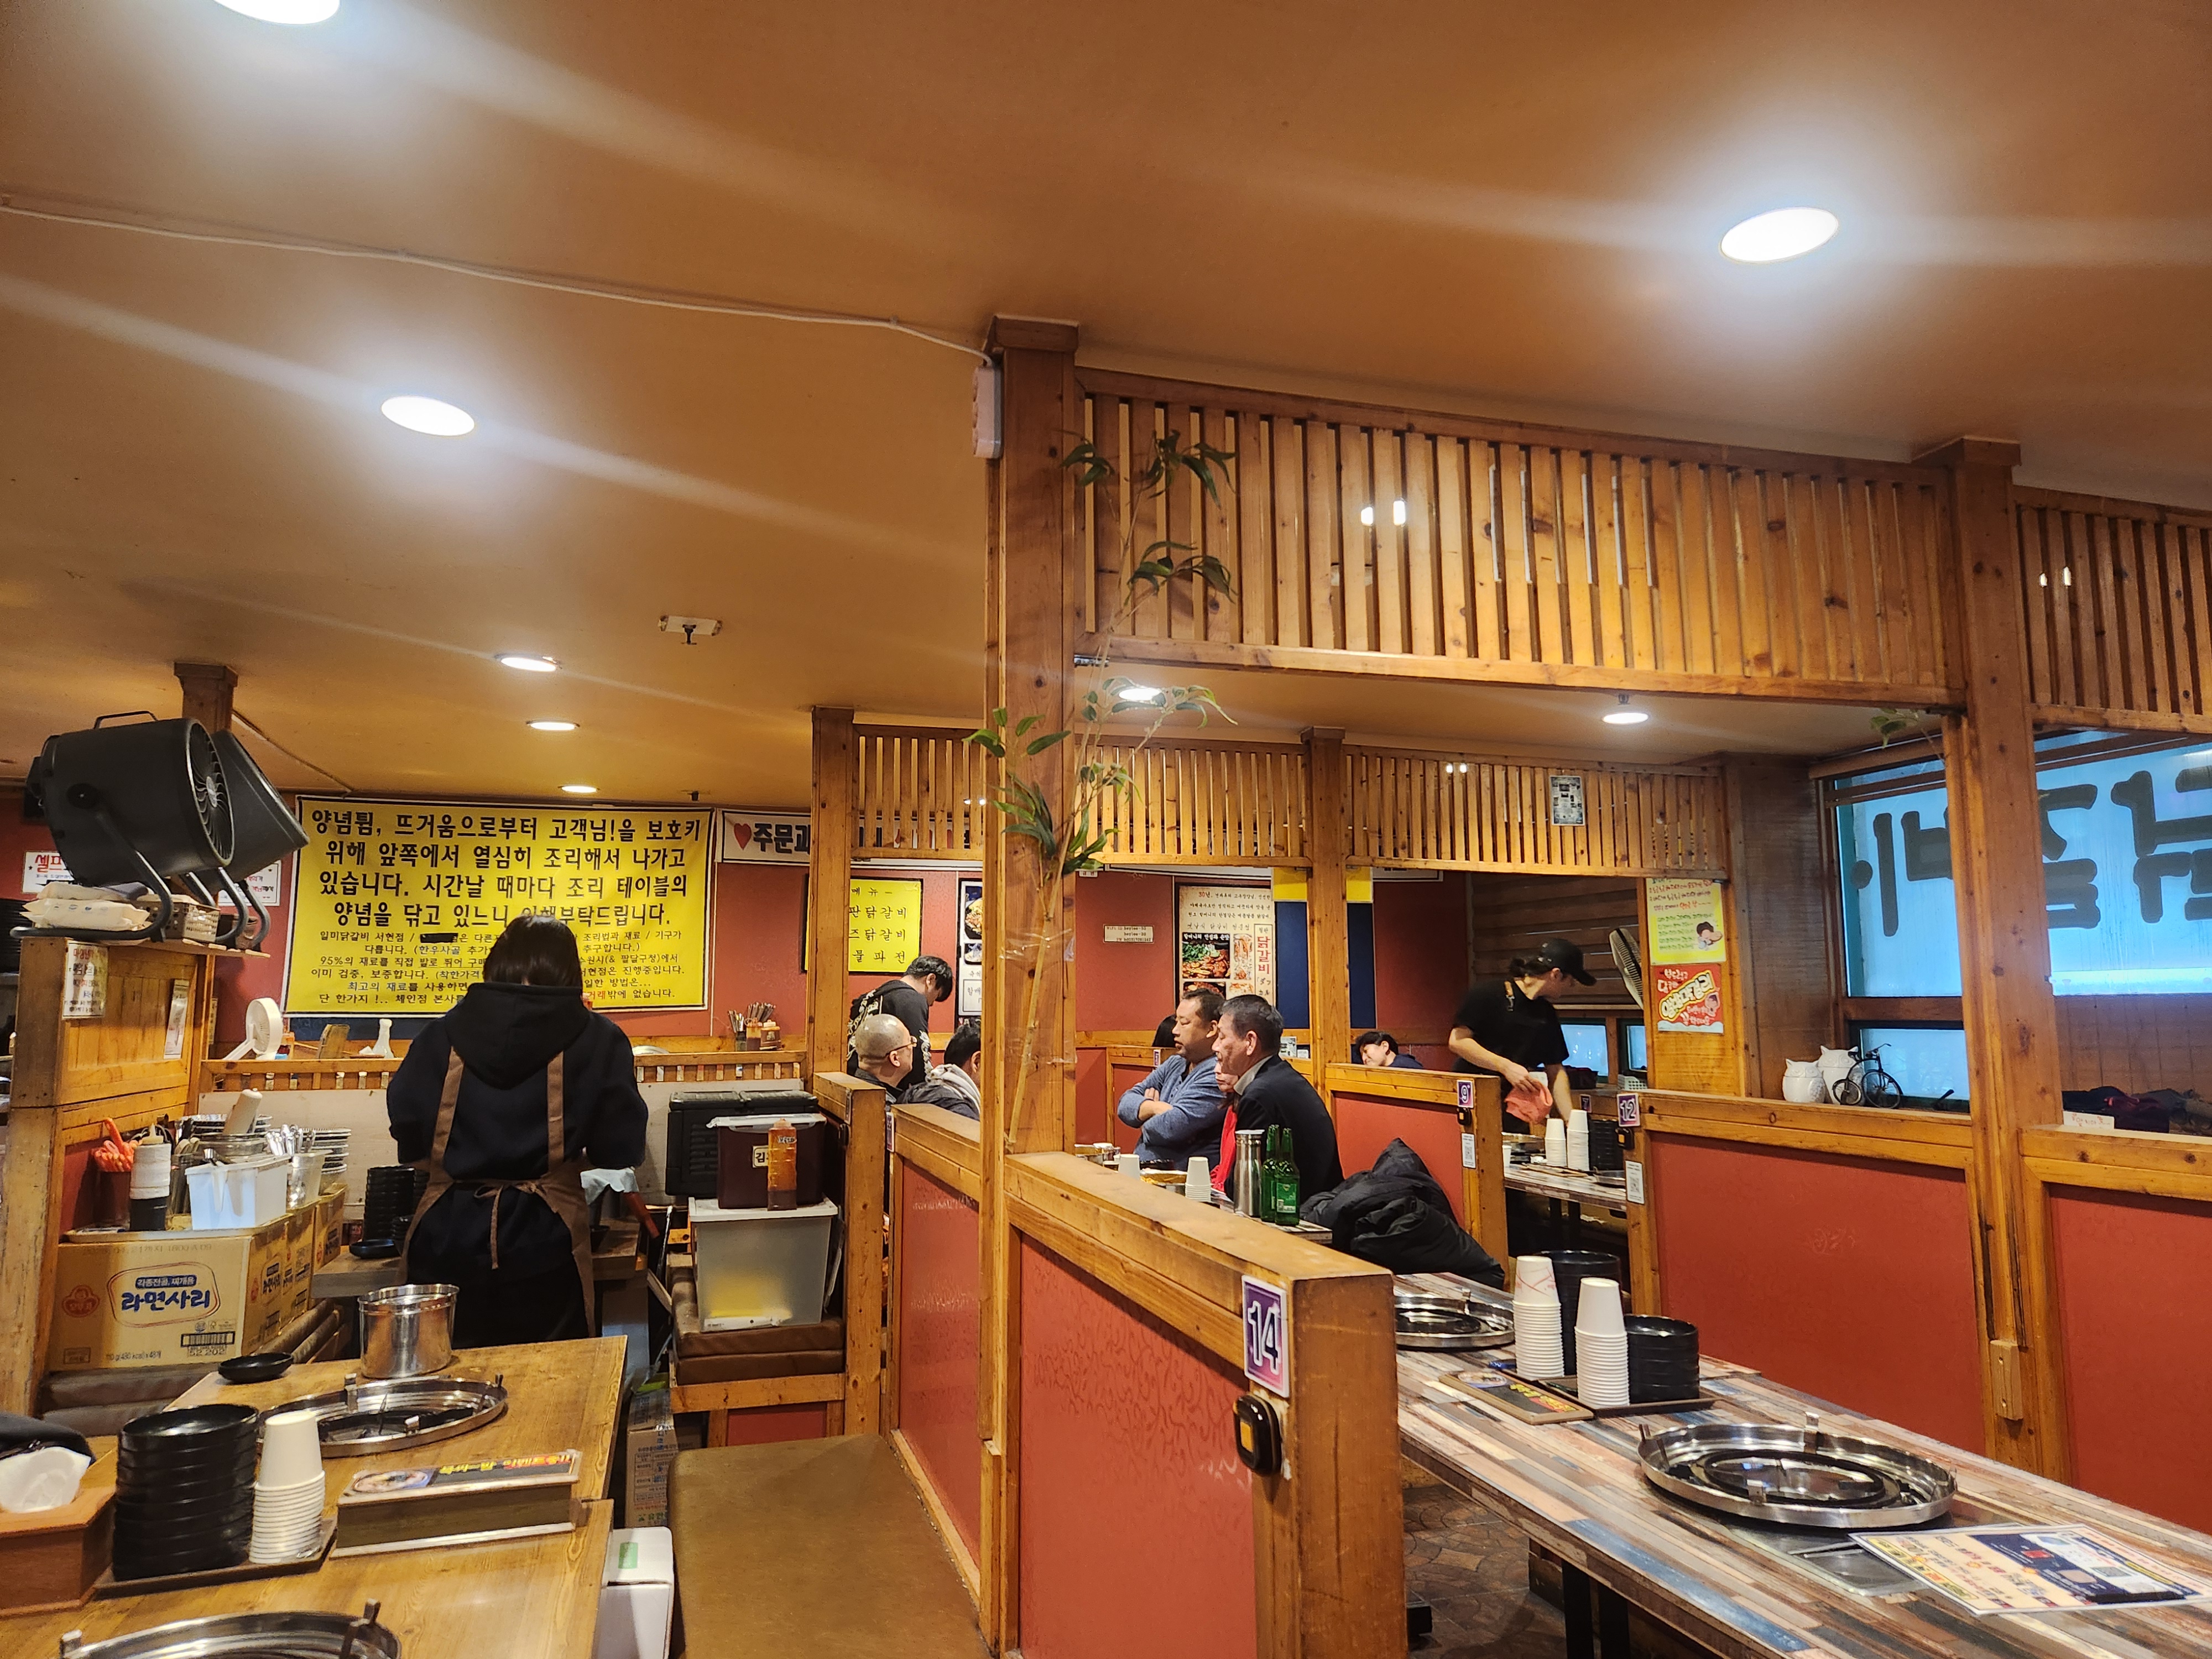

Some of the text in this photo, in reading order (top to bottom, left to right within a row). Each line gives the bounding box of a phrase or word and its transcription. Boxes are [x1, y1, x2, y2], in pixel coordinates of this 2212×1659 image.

[312, 810, 700, 842] 양념튐, 뜨거움으로부터 고객님!을 보호키
[326, 841, 685, 870] 위해 앞쪽에서 열심히 조리해서 나가고
[320, 871, 686, 899] 있습니다. 시간날 때마다 조리 테이블의
[334, 901, 392, 927] 양념을
[404, 904, 441, 927] 닦고
[320, 931, 369, 941] 일미닭갈비
[375, 932, 404, 942] 서현점
[655, 930, 681, 940] 기구가
[414, 946, 461, 954] (한우사골
[467, 946, 492, 954] 추가
[1257, 936, 1271, 974] 닭갈비
[321, 956, 353, 966] 95%의
[359, 957, 388, 967] 재료를
[395, 957, 413, 967] 직접
[311, 969, 332, 978] 이미
[623, 966, 685, 975] 진행중입니다.
[320, 994, 330, 1003] 단
[336, 994, 368, 1004] 한가지
[396, 994, 427, 1004] 체인점
[633, 989, 676, 999] 없습니다.
[348, 982, 379, 991] 최고의
[387, 982, 418, 992] 재료를
[1461, 1085, 1469, 1103] 9
[1582, 1098, 1589, 1109] 7
[1620, 1098, 1636, 1121] 12
[121, 1290, 211, 1312] 라면사리
[1248, 1300, 1280, 1375] 14
